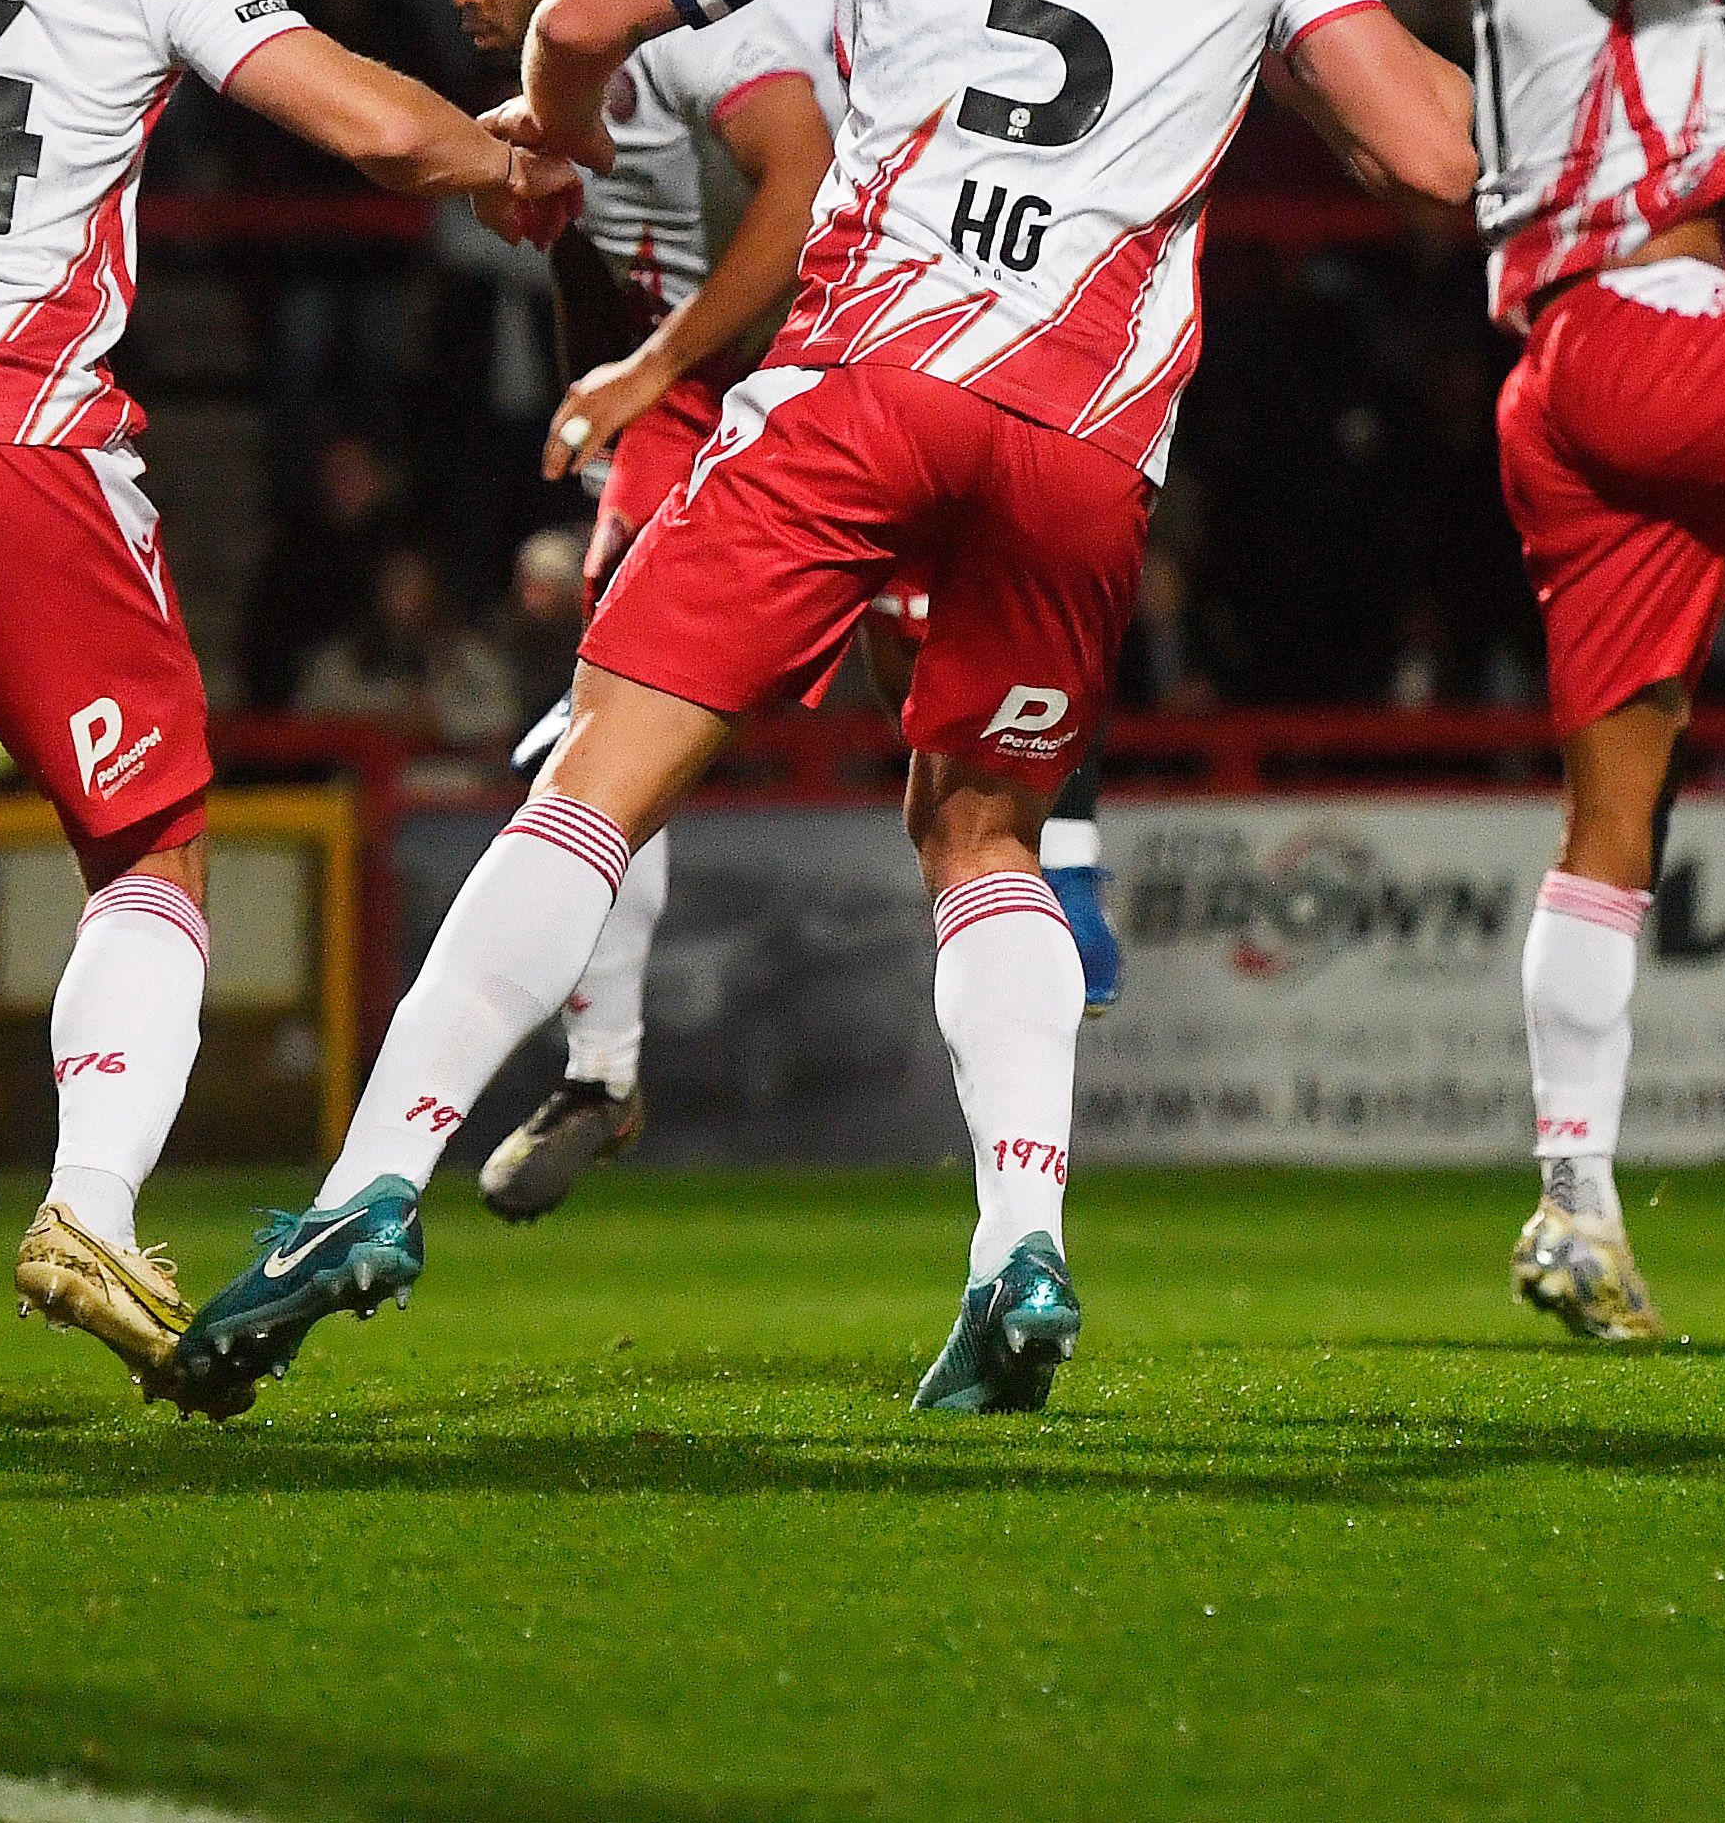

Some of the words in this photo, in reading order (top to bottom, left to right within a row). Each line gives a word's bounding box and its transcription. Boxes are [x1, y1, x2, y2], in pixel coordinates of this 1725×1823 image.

[950, 179, 1052, 272] HG
[406, 1096, 463, 1144] 19
[993, 1138, 1066, 1186] 1976
